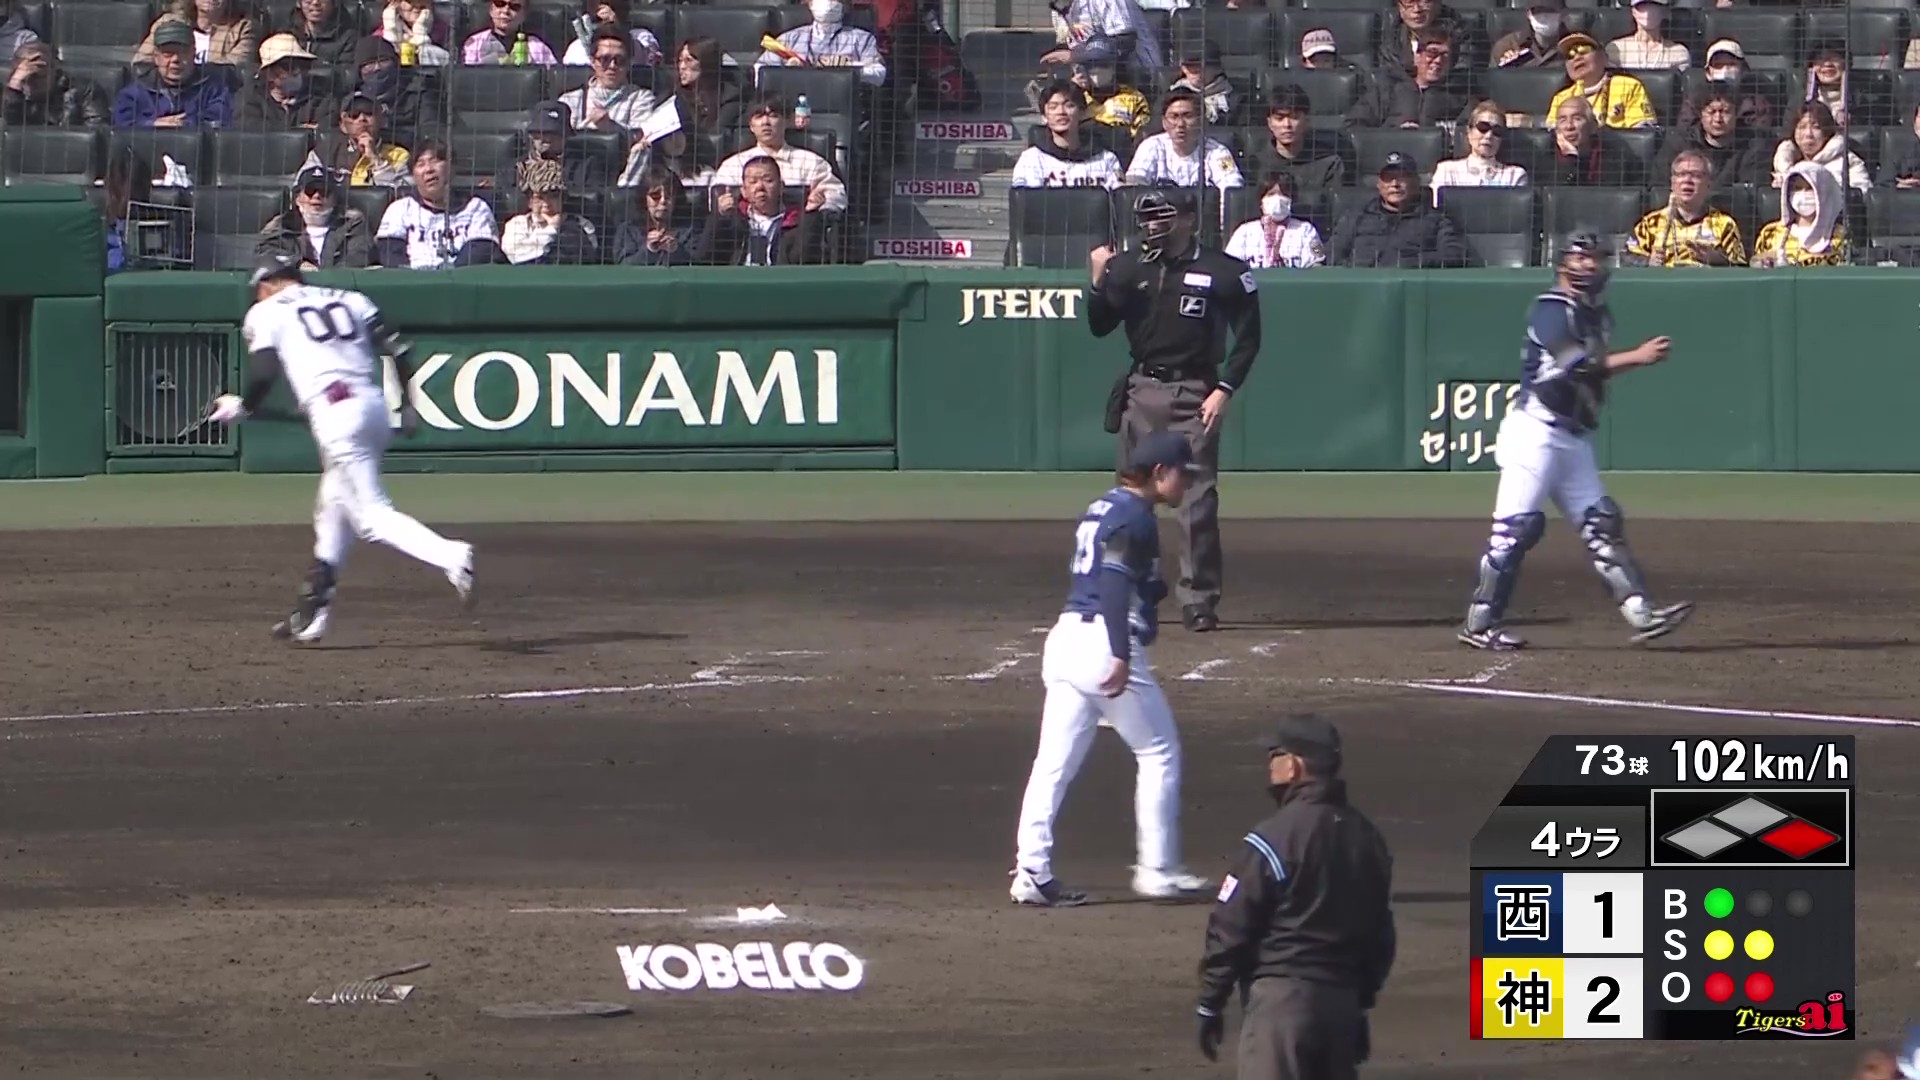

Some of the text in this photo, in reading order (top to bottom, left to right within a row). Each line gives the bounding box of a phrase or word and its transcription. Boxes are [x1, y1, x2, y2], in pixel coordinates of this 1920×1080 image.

[920, 123, 1008, 139] TOSHIBA
[897, 181, 977, 196] TOSHIBA
[878, 240, 967, 257] TOSHIBA
[297, 301, 358, 344] 00
[958, 288, 1083, 326] JTEKT
[381, 348, 840, 431] KONAMI
[616, 941, 866, 992] KOBELCO
